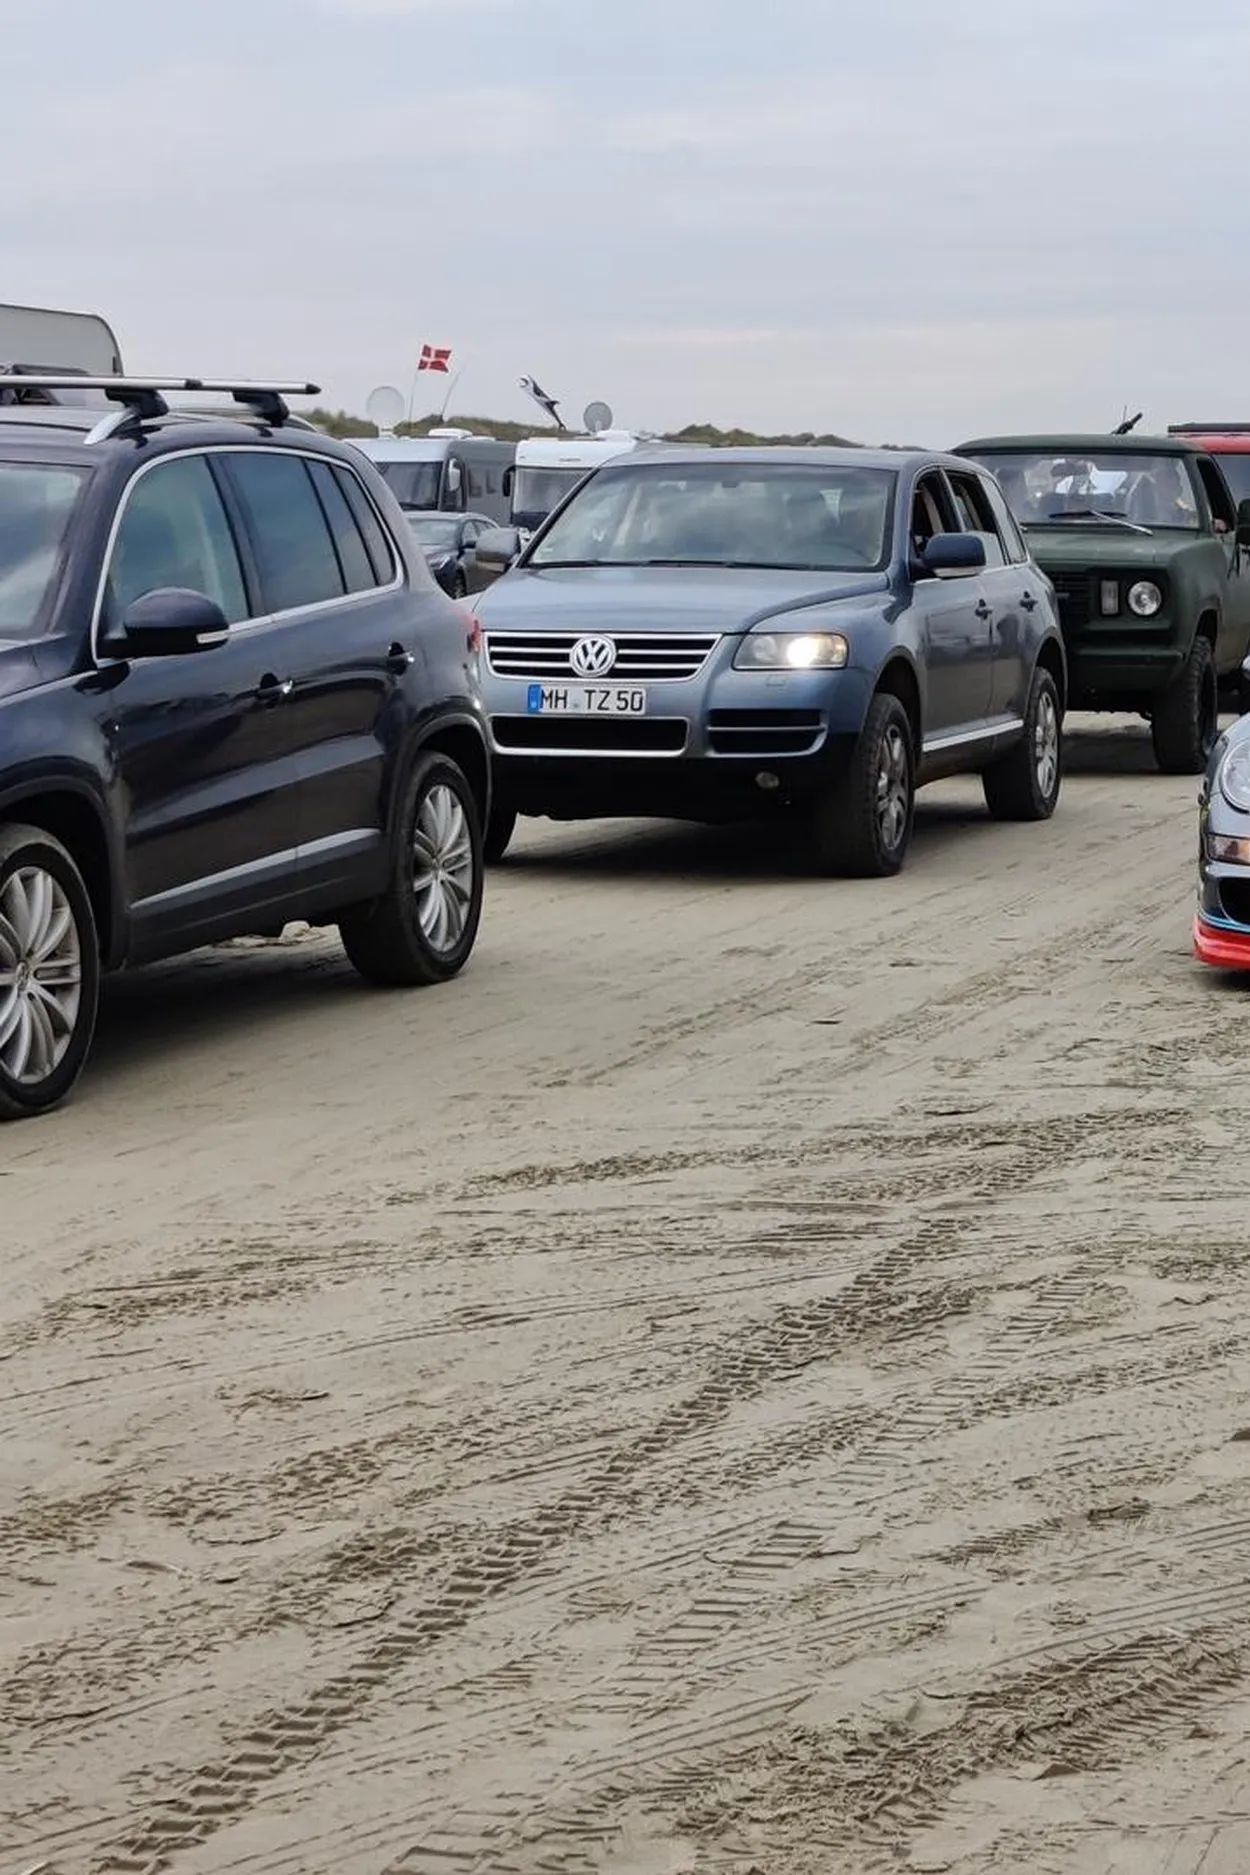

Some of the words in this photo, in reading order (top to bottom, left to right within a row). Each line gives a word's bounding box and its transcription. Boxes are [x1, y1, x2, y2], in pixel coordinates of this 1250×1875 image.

[540, 689, 568, 709] MH
[583, 689, 611, 711] TZ
[615, 690, 644, 712] 50
